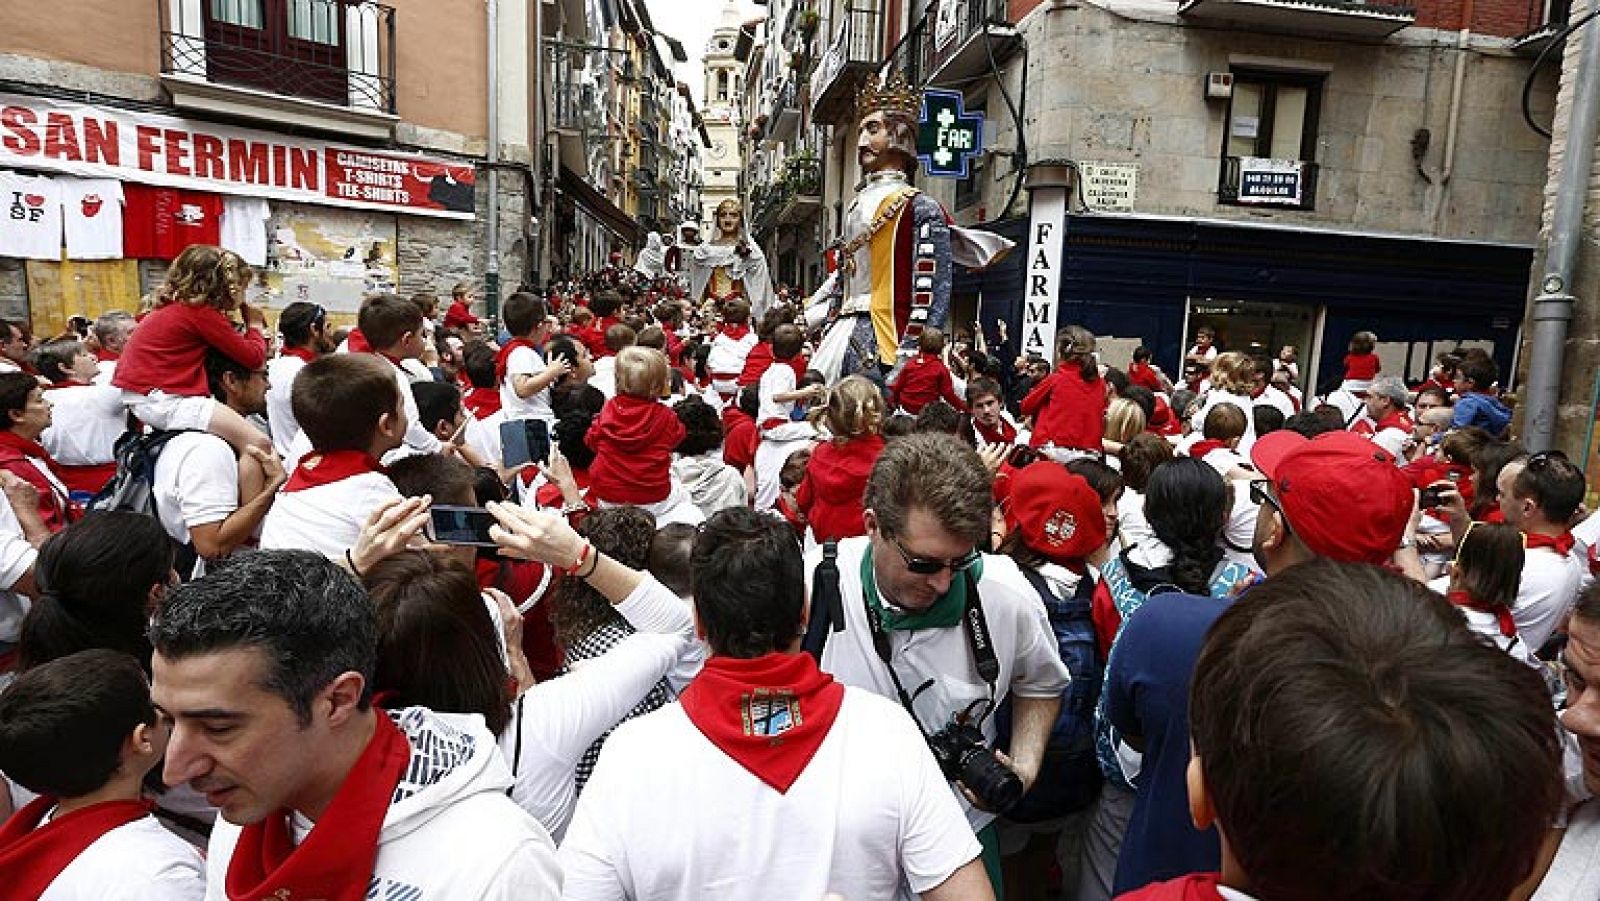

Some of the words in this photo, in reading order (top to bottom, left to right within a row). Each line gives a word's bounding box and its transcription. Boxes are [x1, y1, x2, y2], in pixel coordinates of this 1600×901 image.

[1, 106, 120, 167] SAN
[136, 125, 318, 191] FERMIN
[937, 127, 971, 149] FAR
[344, 168, 403, 189] T-SHIRTS
[12, 191, 24, 205] I
[337, 181, 410, 203] TEE-SHIRTS
